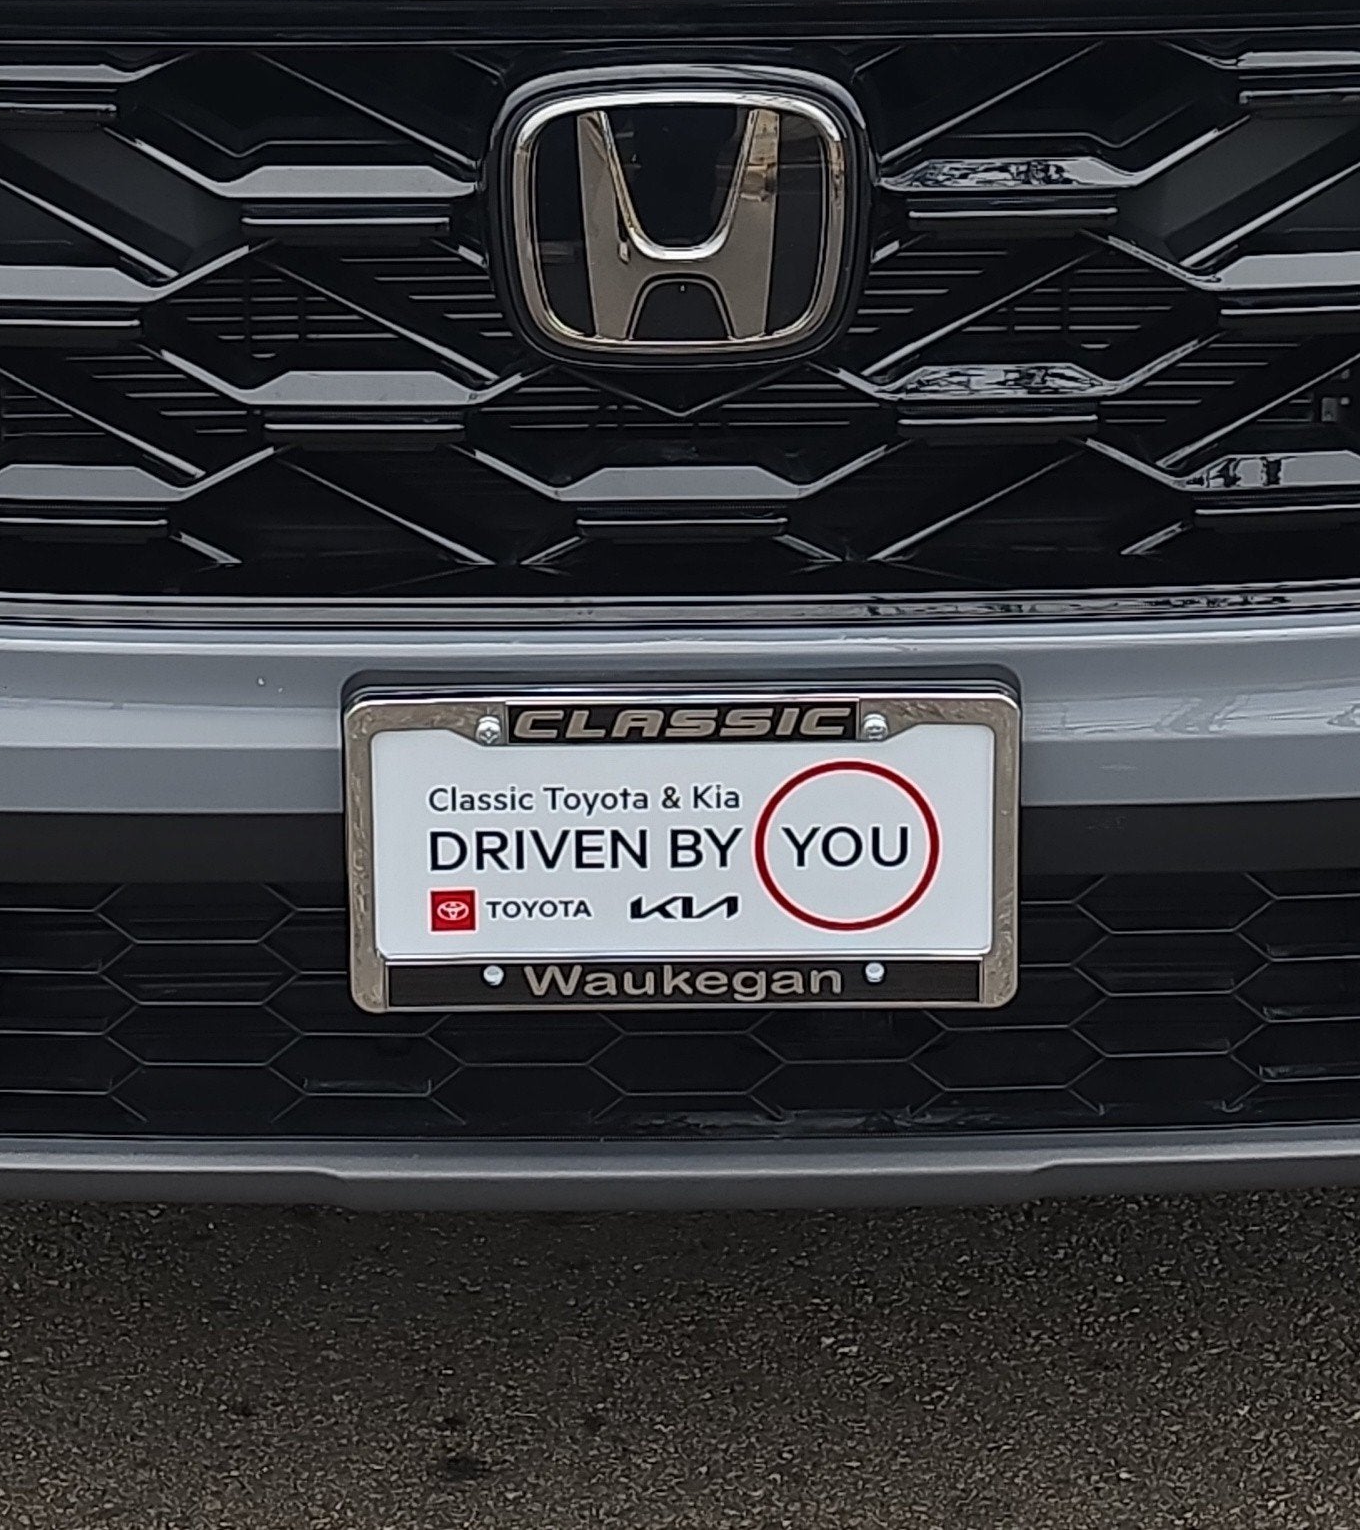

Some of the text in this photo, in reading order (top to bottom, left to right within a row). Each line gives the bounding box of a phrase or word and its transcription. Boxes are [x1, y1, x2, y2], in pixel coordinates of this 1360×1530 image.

[513, 706, 852, 739] CLASSIC
[428, 784, 741, 817] Classic Toyota & Kia
[429, 825, 910, 871] DRIVEN BY YOU
[486, 899, 592, 920] TOYOTA
[522, 964, 842, 1002] Waukegan
